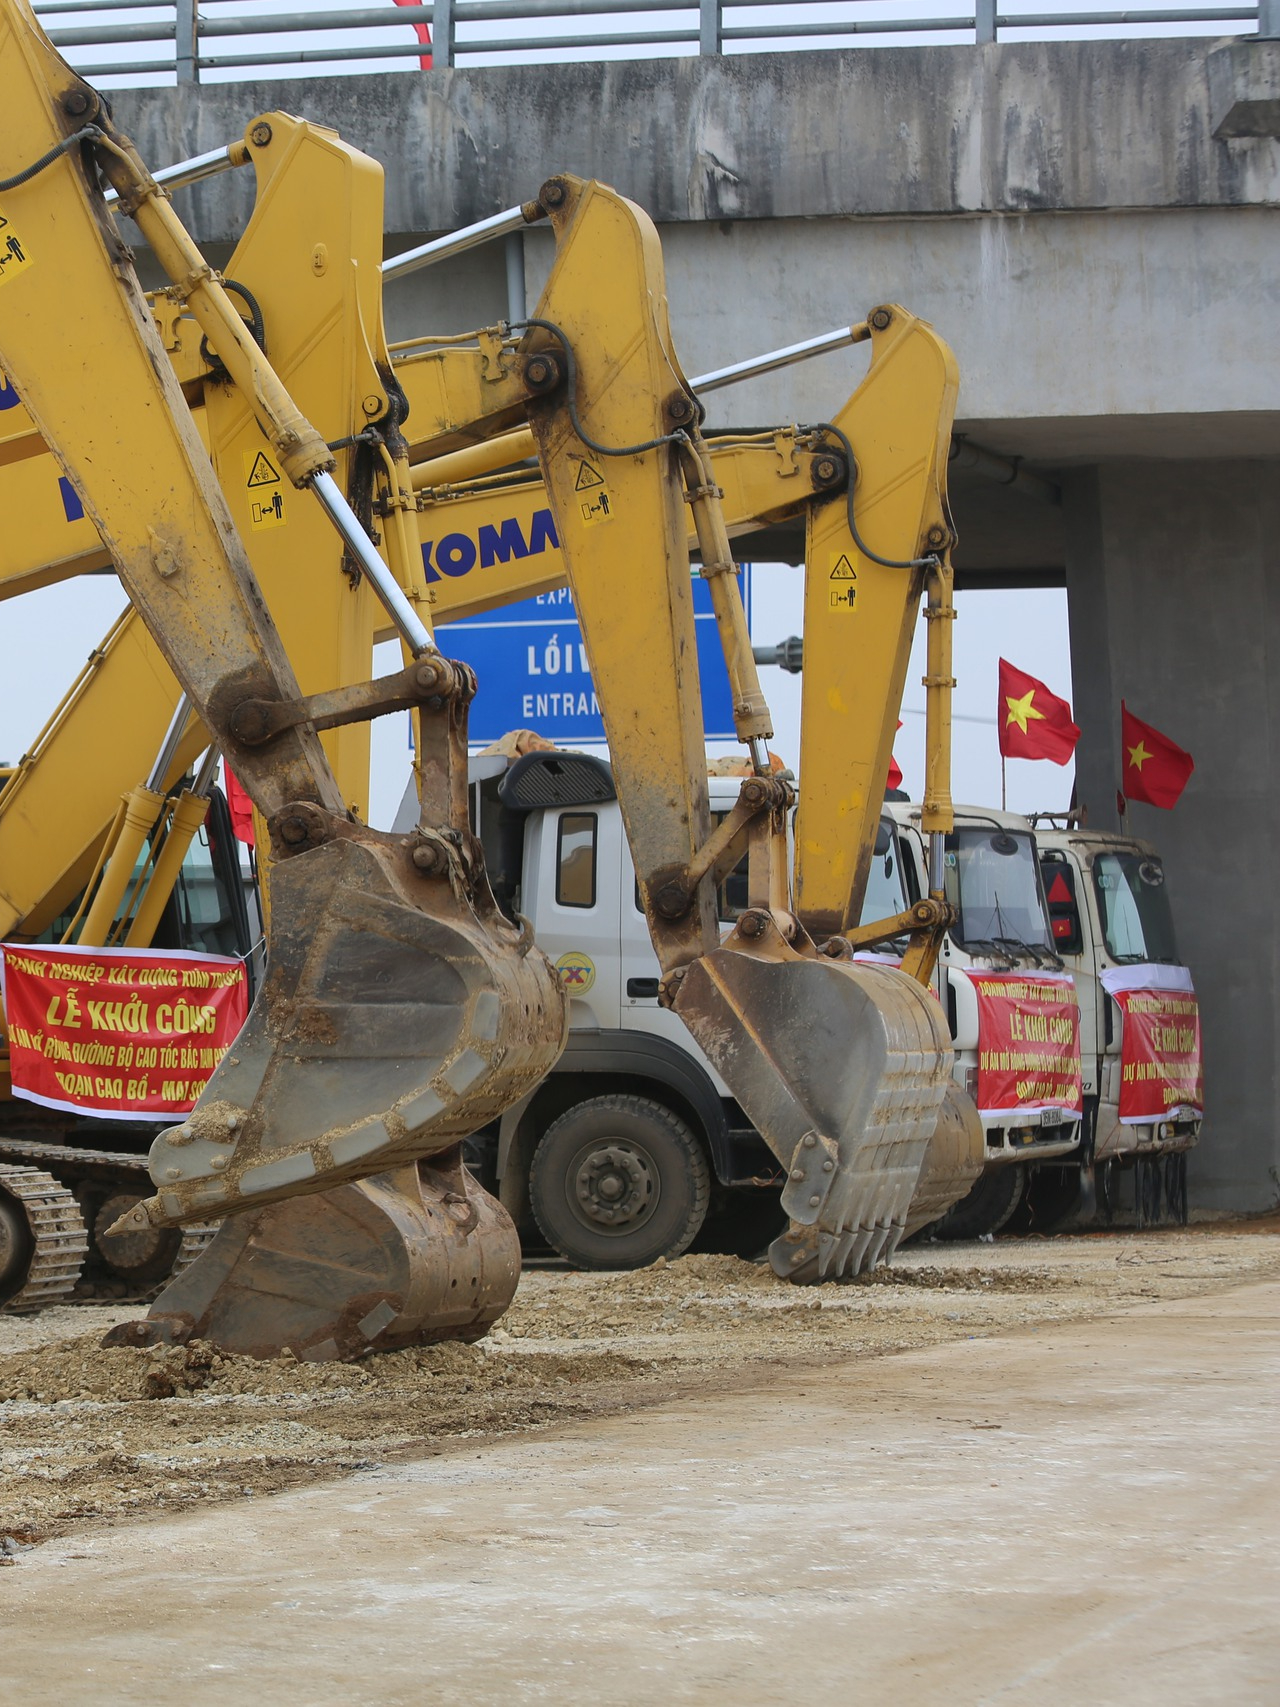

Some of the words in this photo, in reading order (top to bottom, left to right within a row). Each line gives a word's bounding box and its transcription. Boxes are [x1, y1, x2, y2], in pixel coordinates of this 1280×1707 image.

[527, 633, 573, 675] LỐI
[49, 963, 105, 986] NGHIỆP
[108, 965, 138, 985] XÂY
[139, 967, 177, 989] DỰNG
[181, 967, 209, 988] XUÂN
[46, 988, 82, 1028] LỄ
[87, 993, 149, 1033] KHỞI
[156, 998, 216, 1034] CÔNG
[1010, 1004, 1023, 1040] LỄ
[1024, 1007, 1048, 1042] KHỞI
[116, 1042, 133, 1072] BỘ
[135, 1047, 157, 1068] CAO
[160, 1041, 178, 1068] TỐC
[180, 1041, 198, 1068] BẮC
[95, 1077, 123, 1099] CAO
[127, 1073, 148, 1101] BỒ
[162, 1081, 189, 1101] MAI
